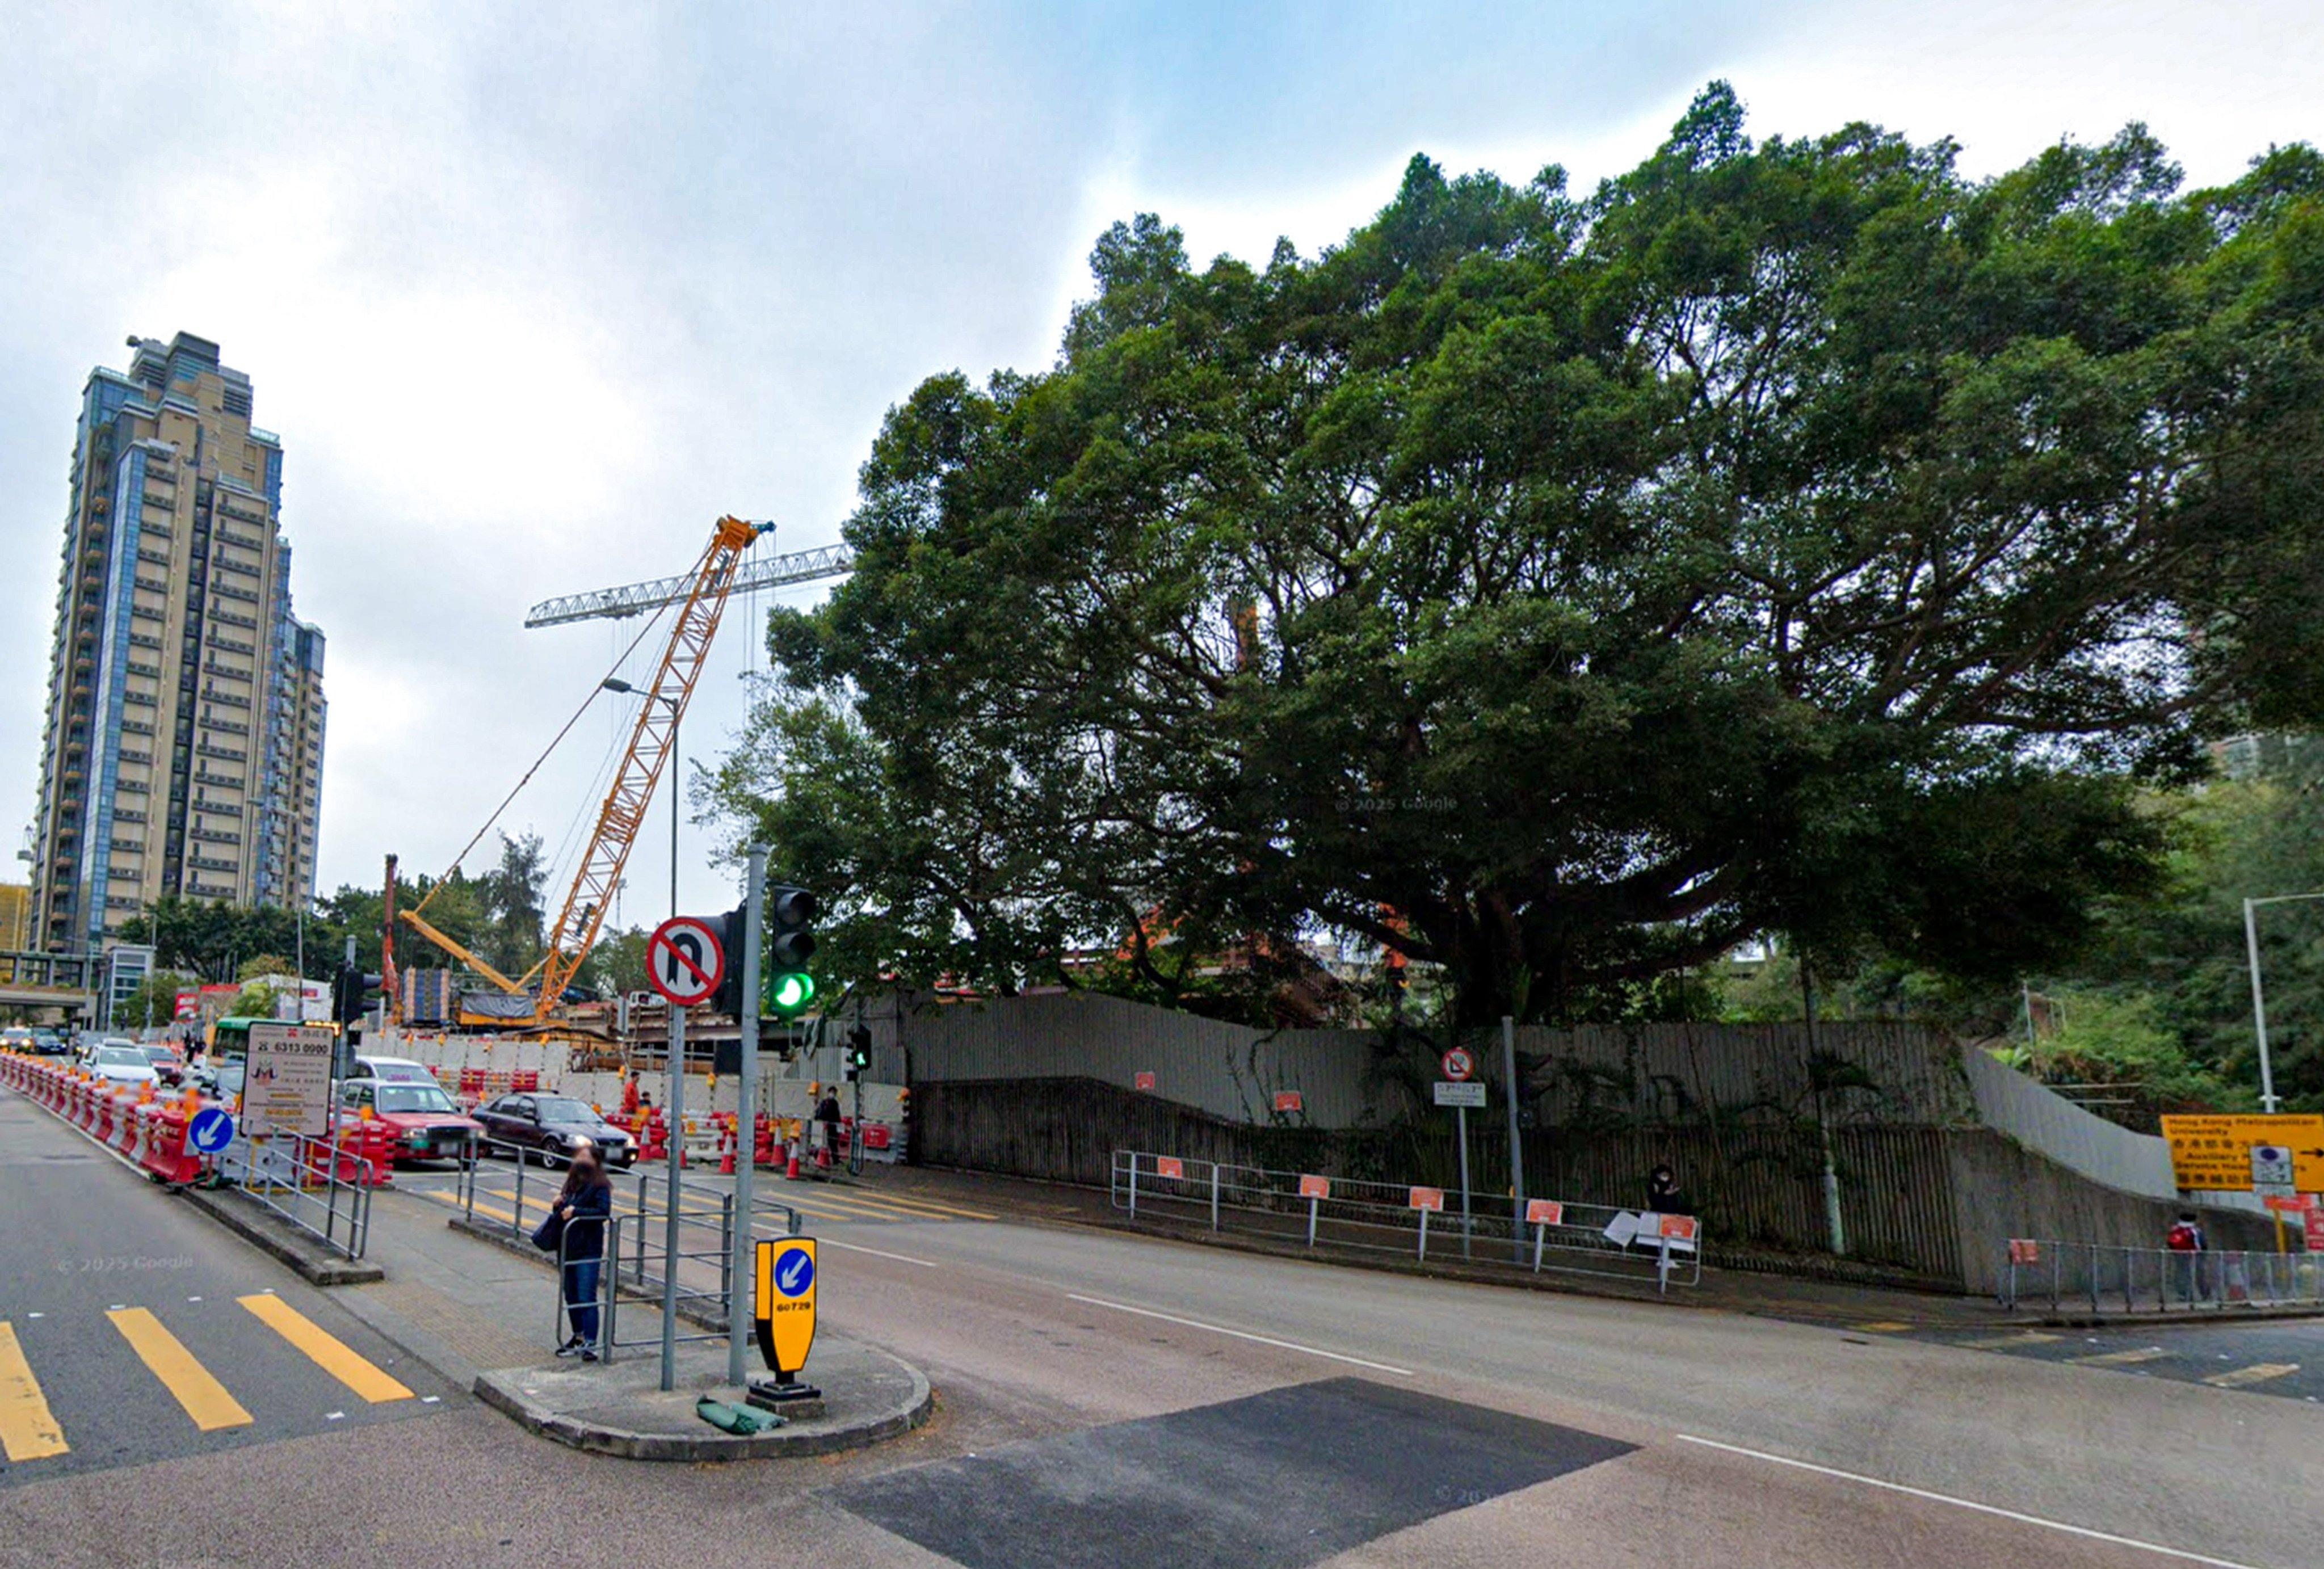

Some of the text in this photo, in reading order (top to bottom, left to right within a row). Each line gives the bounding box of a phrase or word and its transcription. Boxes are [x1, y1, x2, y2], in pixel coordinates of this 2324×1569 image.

[2201, 1118, 2231, 1127] Kong
[2170, 1127, 2229, 1135] University
[776, 1301, 812, 1313] 60729
